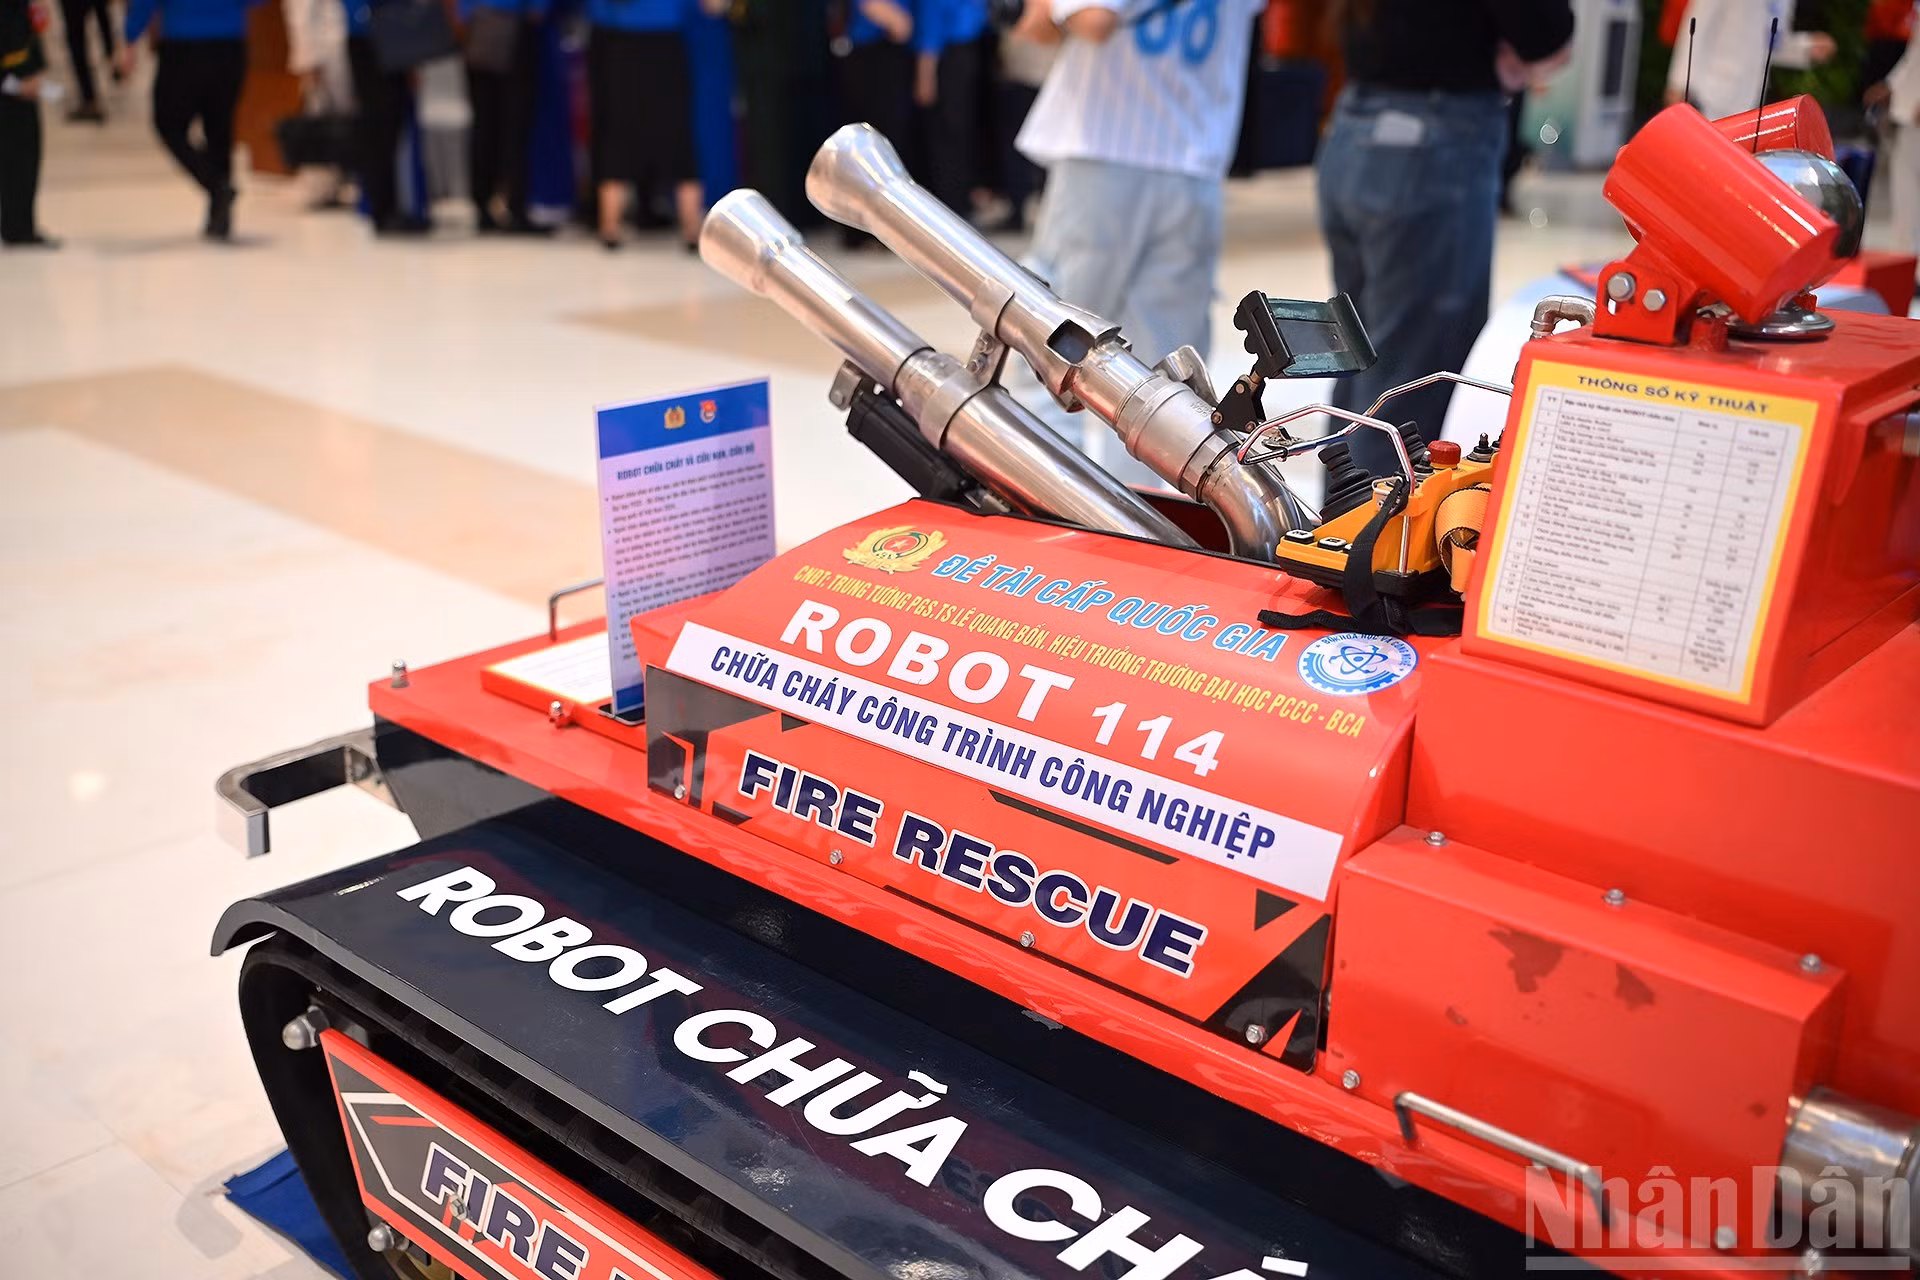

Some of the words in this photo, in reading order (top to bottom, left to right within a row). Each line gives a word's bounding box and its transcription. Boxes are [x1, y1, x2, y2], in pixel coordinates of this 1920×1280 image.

[1577, 375, 1638, 394] THÔNG
[1644, 383, 1670, 398] SỐ
[1708, 395, 1771, 415] THUẬT
[779, 599, 1076, 723] ROBOT
[1091, 701, 1225, 777] 114
[828, 573, 872, 599] TRUNG
[866, 583, 913, 611] TƯỚNG
[951, 607, 977, 628] LÊ
[968, 612, 1020, 641] QUANG
[1047, 634, 1088, 660] HIỆU
[1082, 643, 1146, 676] TRƯỞNG
[1141, 659, 1207, 693] TRƯỜNG
[1202, 676, 1237, 704] ĐẠI
[1231, 684, 1272, 712] HỌC
[1267, 693, 1319, 724] PCCC
[1325, 709, 1366, 739] BCA
[931, 553, 997, 584] ĐỀ
[979, 565, 1046, 598] TÀI
[1034, 579, 1115, 613] CẤP
[1107, 595, 1218, 642] QUỐC
[1212, 622, 1289, 663] GIA
[711, 646, 779, 691] CHỮA
[782, 670, 857, 716] CHÁY
[856, 695, 938, 746] CÔNG
[942, 721, 1036, 779] TRÌNH
[1039, 756, 1133, 813] CÔNG
[1136, 788, 1276, 860] NGHIỆP
[738, 750, 885, 847] FIRE
[892, 810, 1208, 979] RESCUE
[396, 865, 704, 1016] ROBOT
[673, 1009, 968, 1188] CHỮA
[983, 1168, 1308, 1280] CH
[421, 1141, 590, 1280] FIRE
